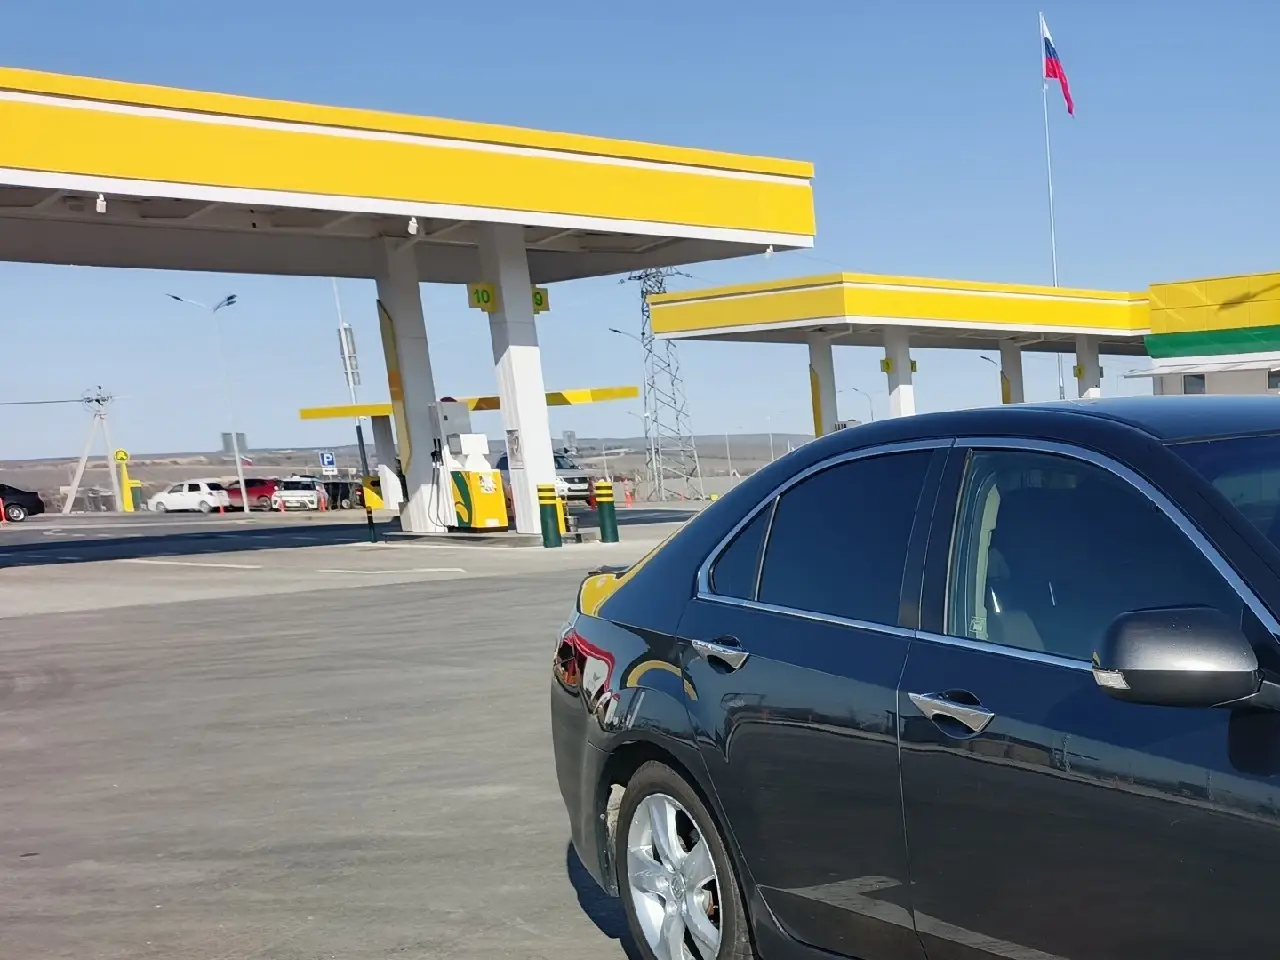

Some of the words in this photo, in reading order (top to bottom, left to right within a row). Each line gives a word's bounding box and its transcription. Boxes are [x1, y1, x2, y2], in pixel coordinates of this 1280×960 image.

[473, 288, 491, 304] 10
[533, 291, 544, 306] 9
[323, 453, 333, 467] P
